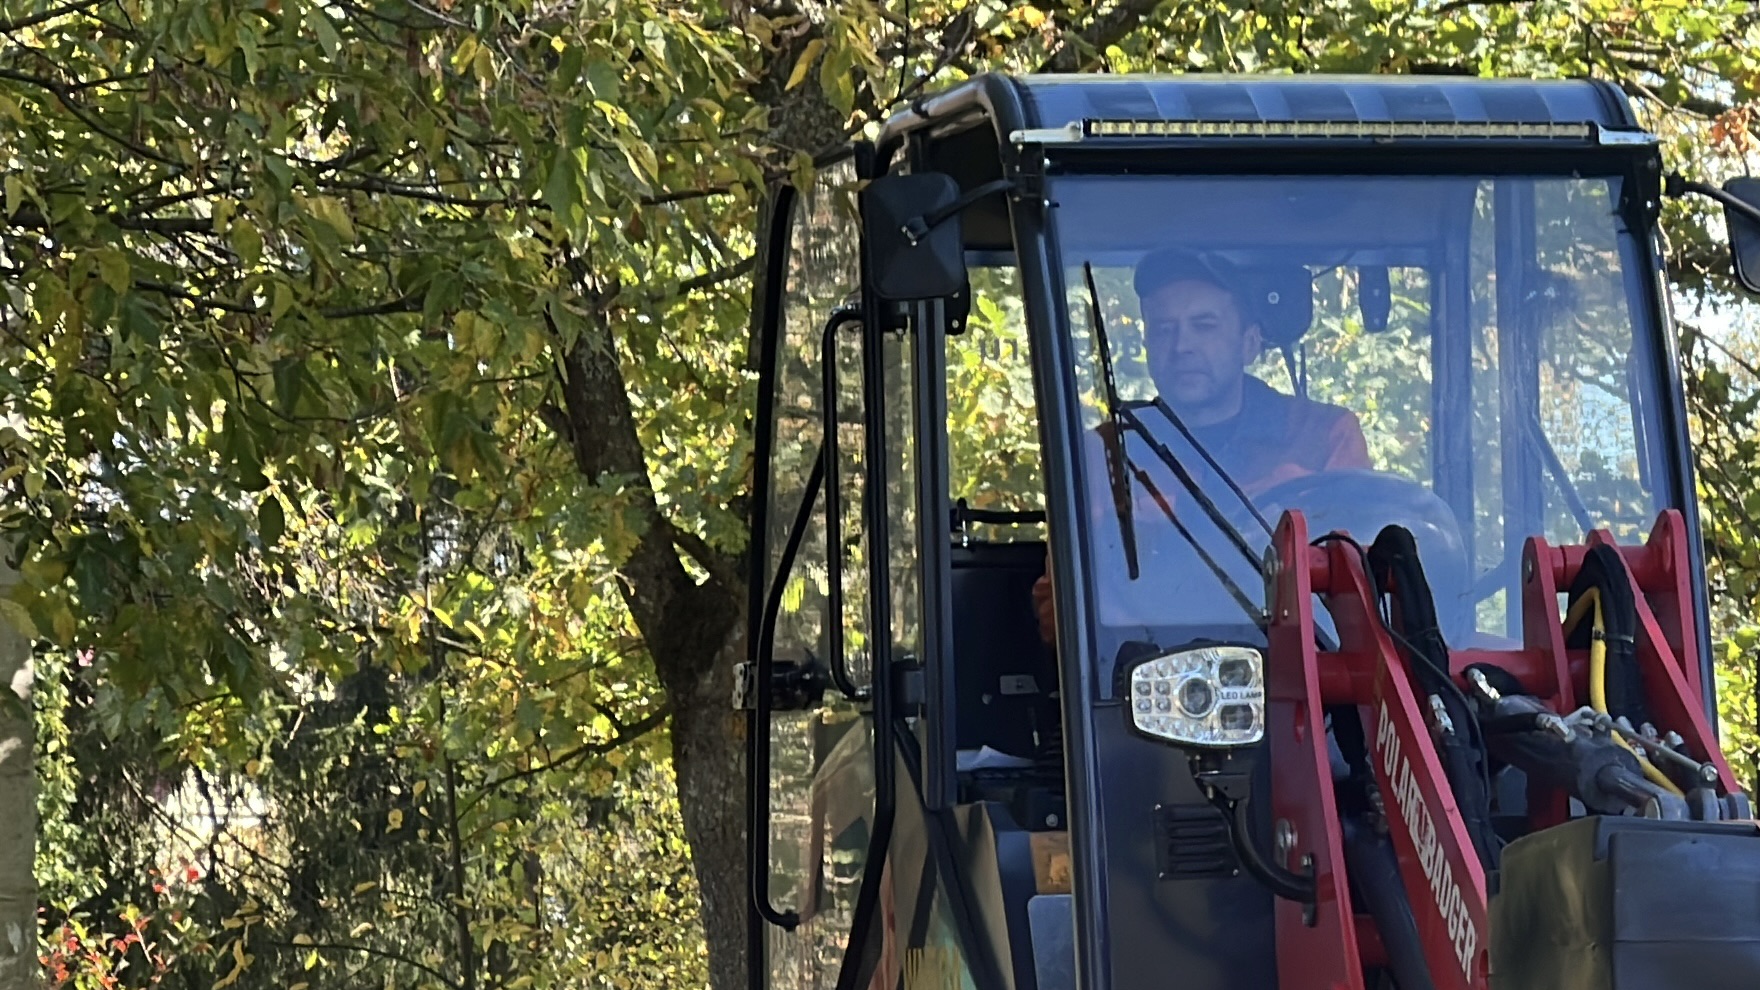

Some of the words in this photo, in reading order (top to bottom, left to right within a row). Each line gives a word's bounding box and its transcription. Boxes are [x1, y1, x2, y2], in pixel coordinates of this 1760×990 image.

[1221, 692, 1238, 700] LED
[1240, 691, 1263, 700] LAMP
[1376, 698, 1421, 829] POLAR
[1423, 818, 1476, 985] BADGER
